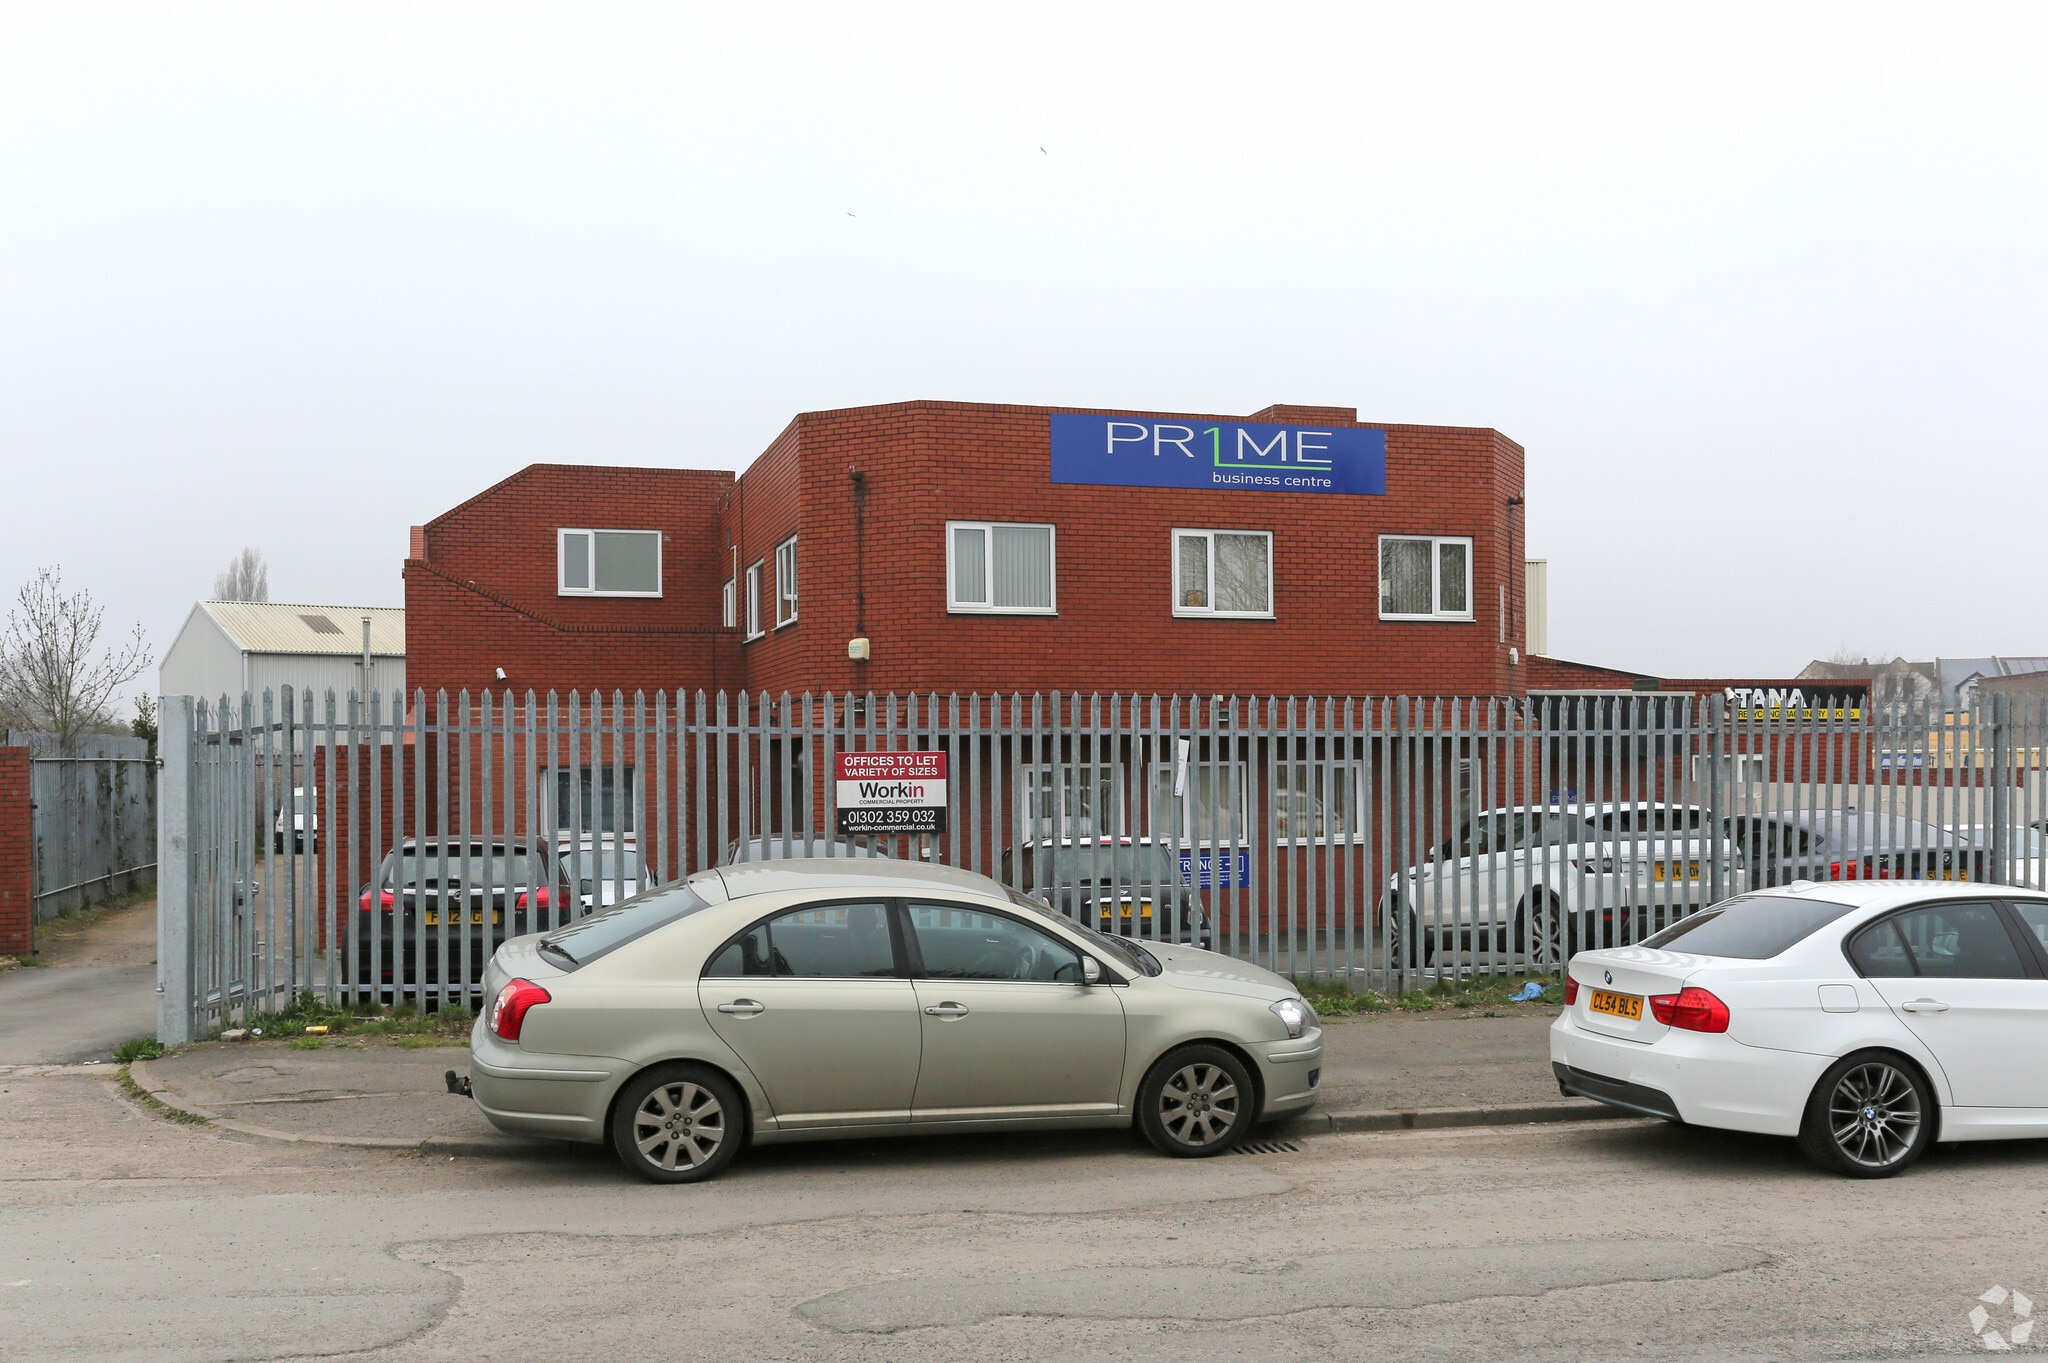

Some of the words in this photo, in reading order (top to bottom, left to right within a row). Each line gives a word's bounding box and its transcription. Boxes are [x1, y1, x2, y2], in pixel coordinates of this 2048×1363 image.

[1213, 471, 1280, 485] business
[1284, 475, 1332, 487] centre
[1734, 688, 1808, 708] TANA
[844, 756, 894, 767] OFFICES
[897, 756, 914, 766] TO
[916, 755, 938, 765] LET
[845, 768, 888, 777] VARIETY
[891, 767, 906, 776] OF
[908, 767, 938, 776] SIZES
[859, 781, 924, 798] Workin
[848, 811, 884, 823] 01302
[887, 810, 910, 823] 359
[912, 810, 935, 822] 032
[848, 823, 936, 831] workin-commercial.co.uk
[1593, 993, 1616, 1012] CL54
[1618, 998, 1639, 1016] BLS
